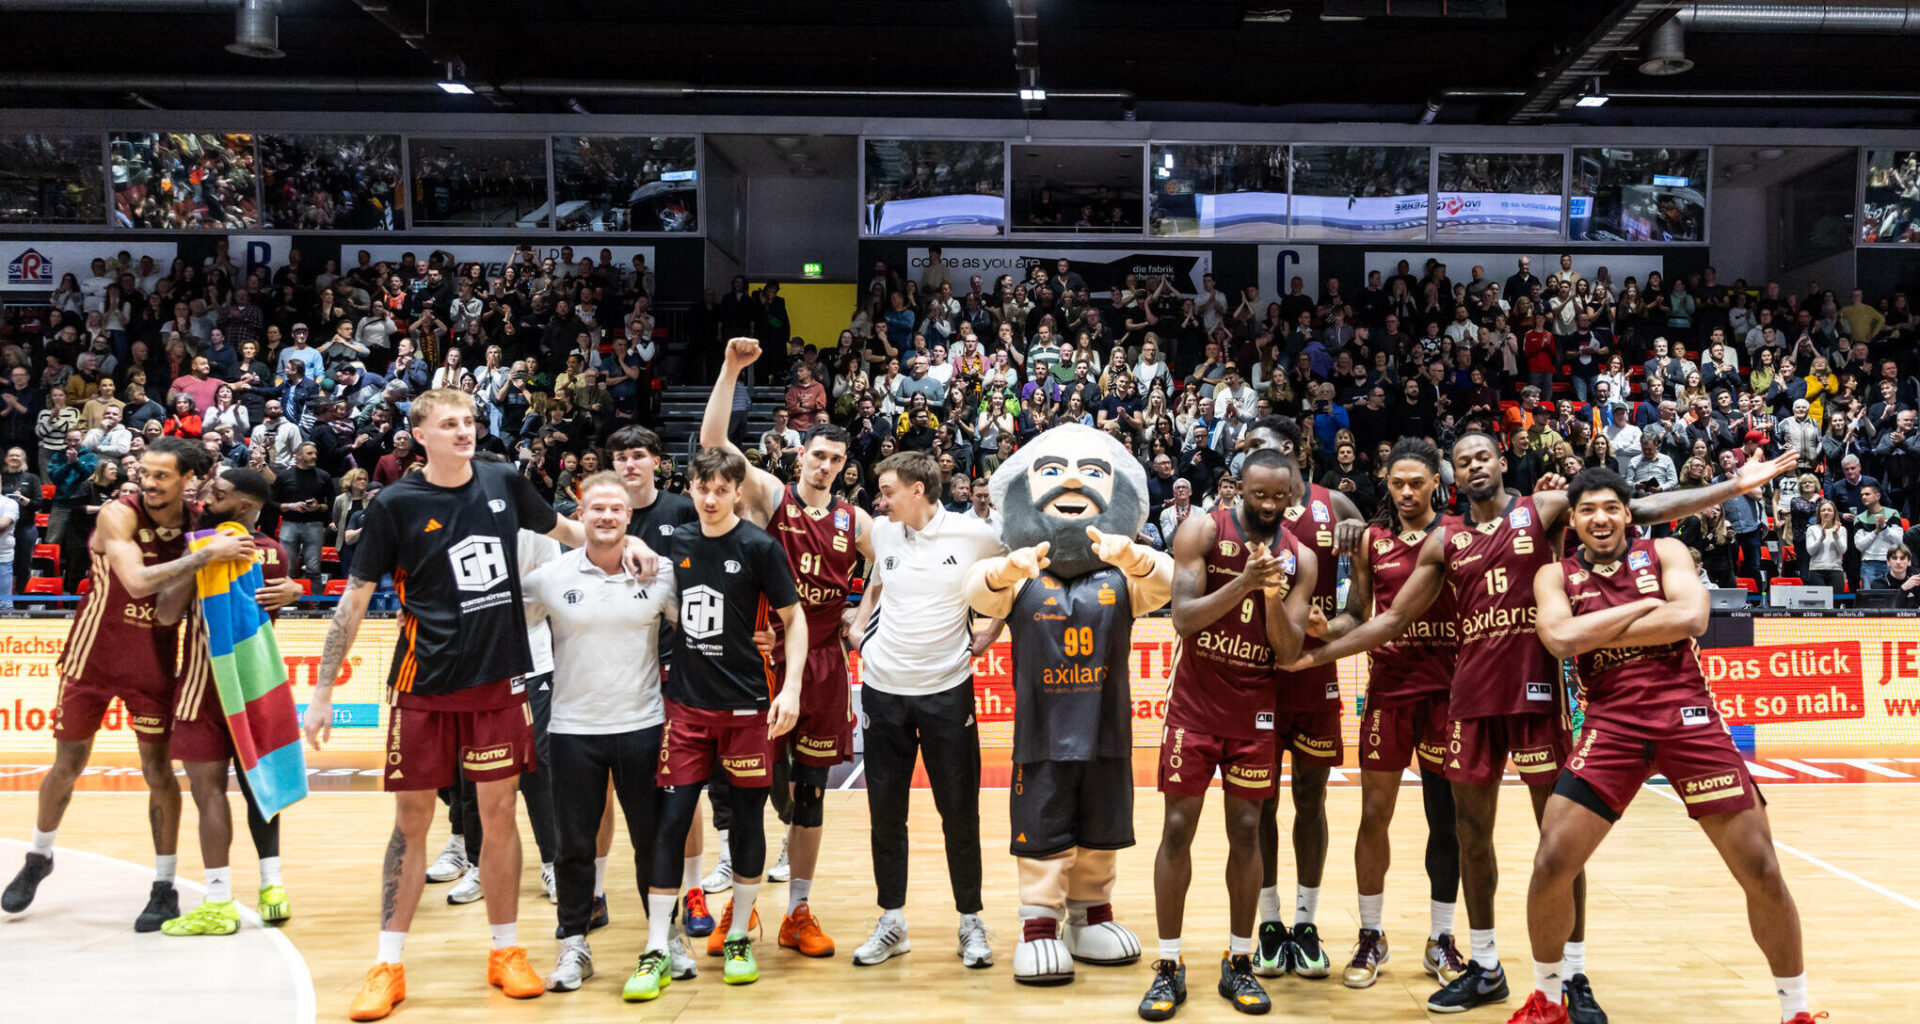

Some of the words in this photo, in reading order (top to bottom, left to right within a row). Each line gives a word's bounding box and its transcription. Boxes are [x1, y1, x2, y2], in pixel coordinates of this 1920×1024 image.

[911, 257, 959, 268] coe
[962, 257, 980, 268] as
[983, 257, 1012, 271] you
[1132, 265, 1147, 274] die
[1148, 265, 1175, 274] fabrik
[1276, 249, 1300, 299] C
[1782, 481, 1797, 491] 17
[800, 552, 821, 576] 91
[1485, 567, 1508, 595] 15
[123, 603, 154, 620] ax
[1240, 598, 1254, 623] 9
[0, 635, 67, 654] fachst
[1064, 626, 1094, 657] 99
[1197, 630, 1271, 663] axilaris
[0, 661, 22, 677] är
[28, 664, 49, 677] zu
[1708, 655, 1761, 681] Das
[1769, 648, 1851, 677] Glück
[1878, 641, 1919, 686] JE
[1719, 694, 1747, 718] st
[1754, 696, 1787, 717] so
[1796, 686, 1857, 714] nah.
[808, 739, 834, 749] LOTTO
[1305, 737, 1334, 749] LOTTO
[475, 749, 508, 761] LOTTO
[731, 758, 760, 768] LOTTO
[1241, 769, 1270, 779] LOTTO
[1697, 775, 1735, 790] LOTTO
